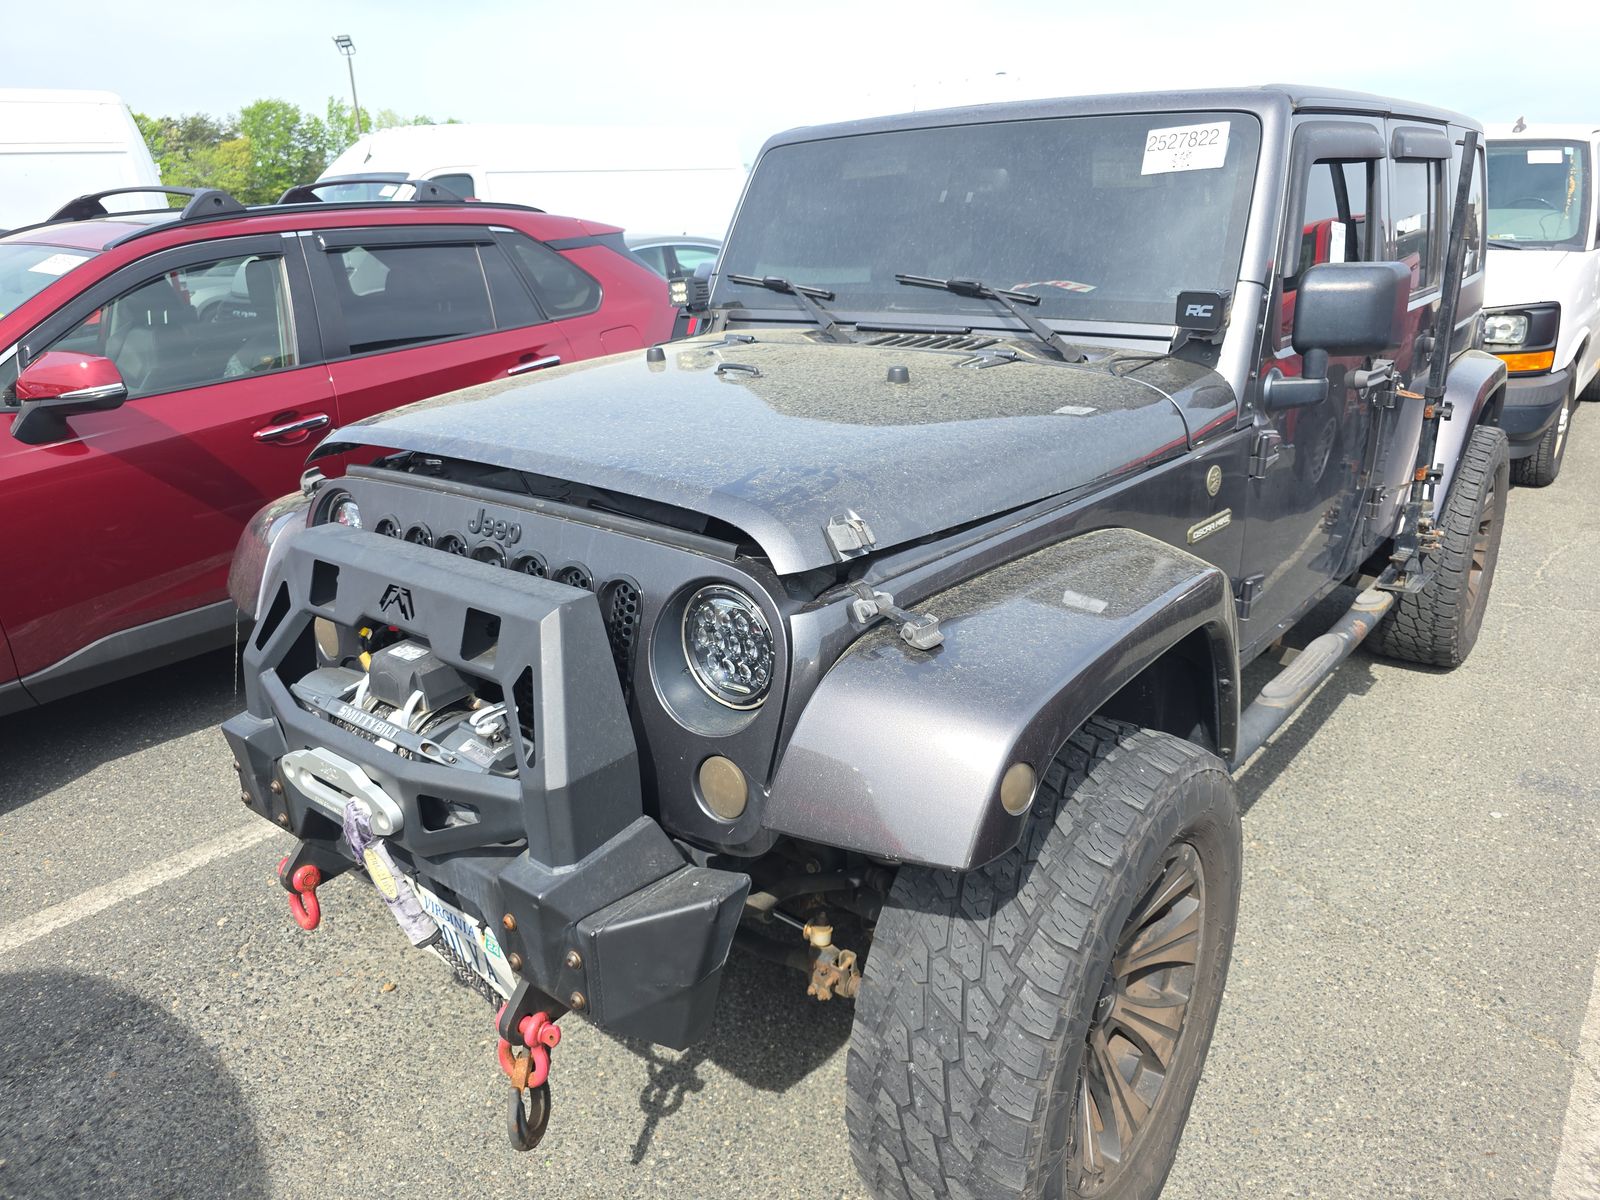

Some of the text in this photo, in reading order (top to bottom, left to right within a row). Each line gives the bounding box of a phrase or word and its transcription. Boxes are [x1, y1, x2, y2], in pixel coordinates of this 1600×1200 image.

[1147, 128, 1220, 152] 2527822
[1185, 304, 1214, 317] RC
[468, 508, 522, 548] Jeep
[337, 705, 401, 738] SMITTYBILT
[424, 895, 476, 940] VIRGINIA
[433, 918, 501, 985] OLVA
